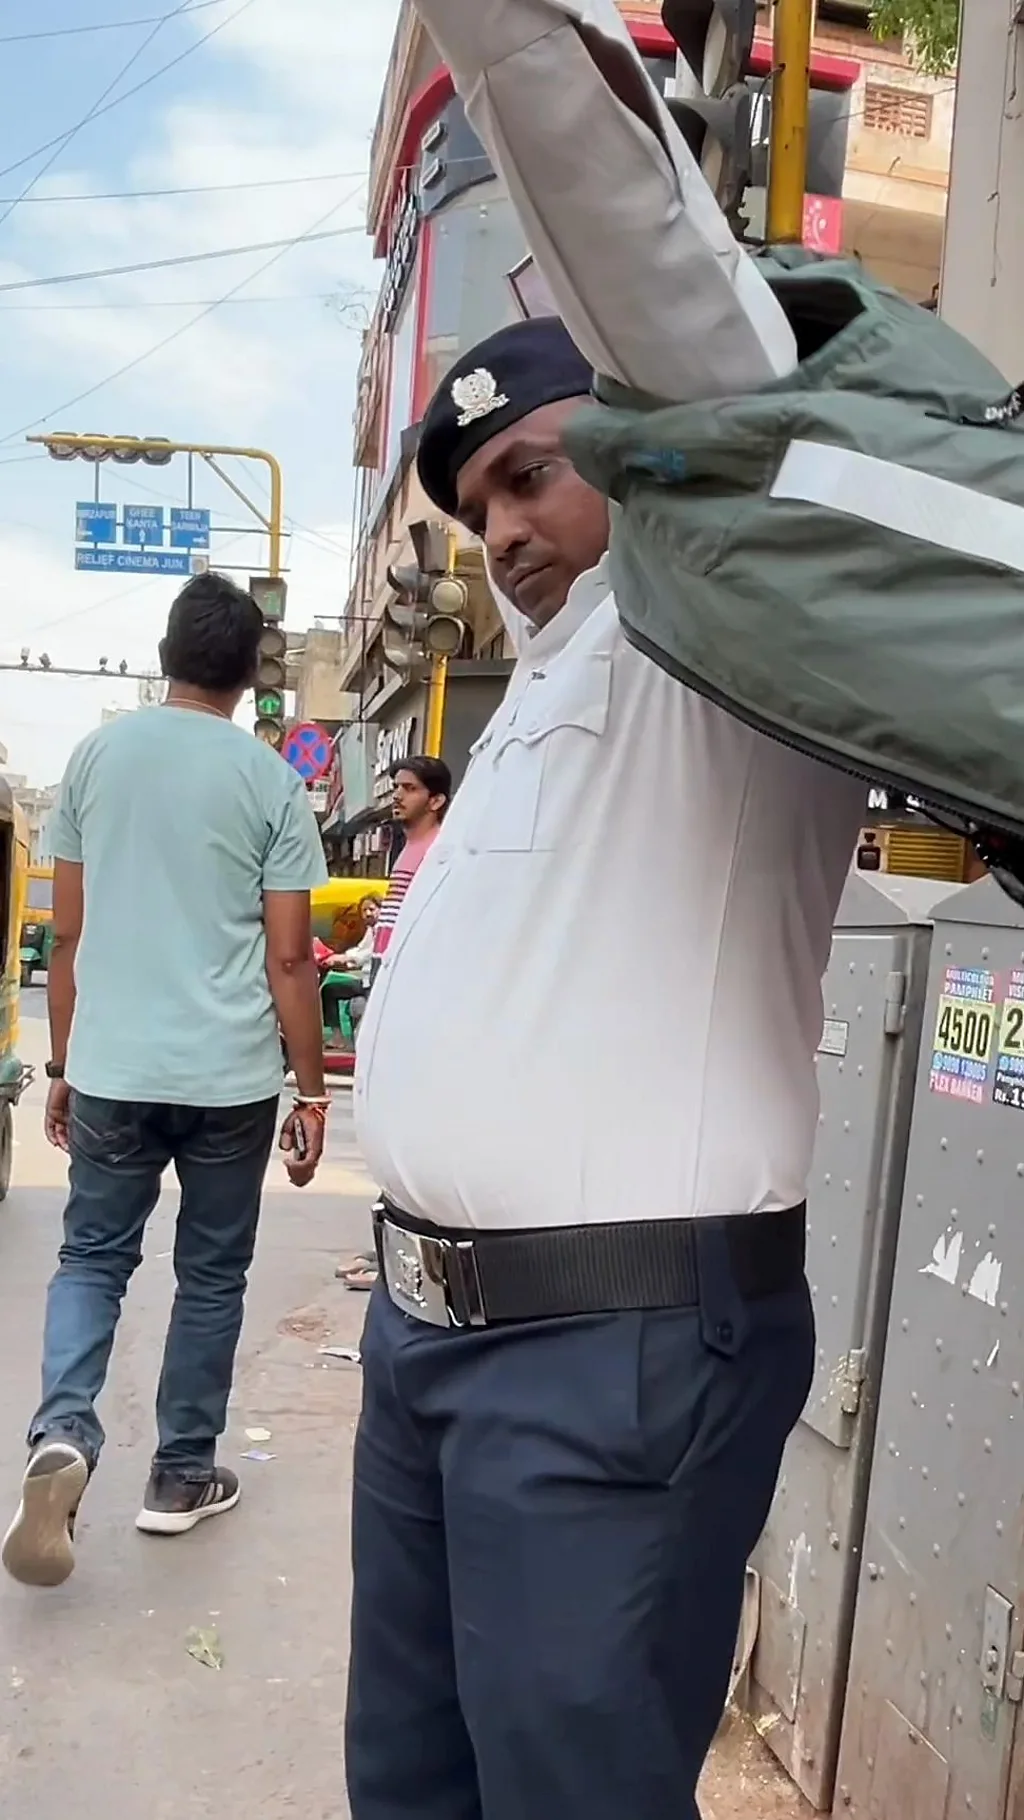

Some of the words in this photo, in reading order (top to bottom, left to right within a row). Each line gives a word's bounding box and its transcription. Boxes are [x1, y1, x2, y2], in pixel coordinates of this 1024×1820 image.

[126, 519, 158, 529] KANTA
[77, 553, 115, 566] RELIEF
[117, 555, 159, 568] CINEMA
[944, 982, 993, 1002] PAMPHLET
[939, 1006, 991, 1057] 4500
[929, 1071, 950, 1093] FLEX
